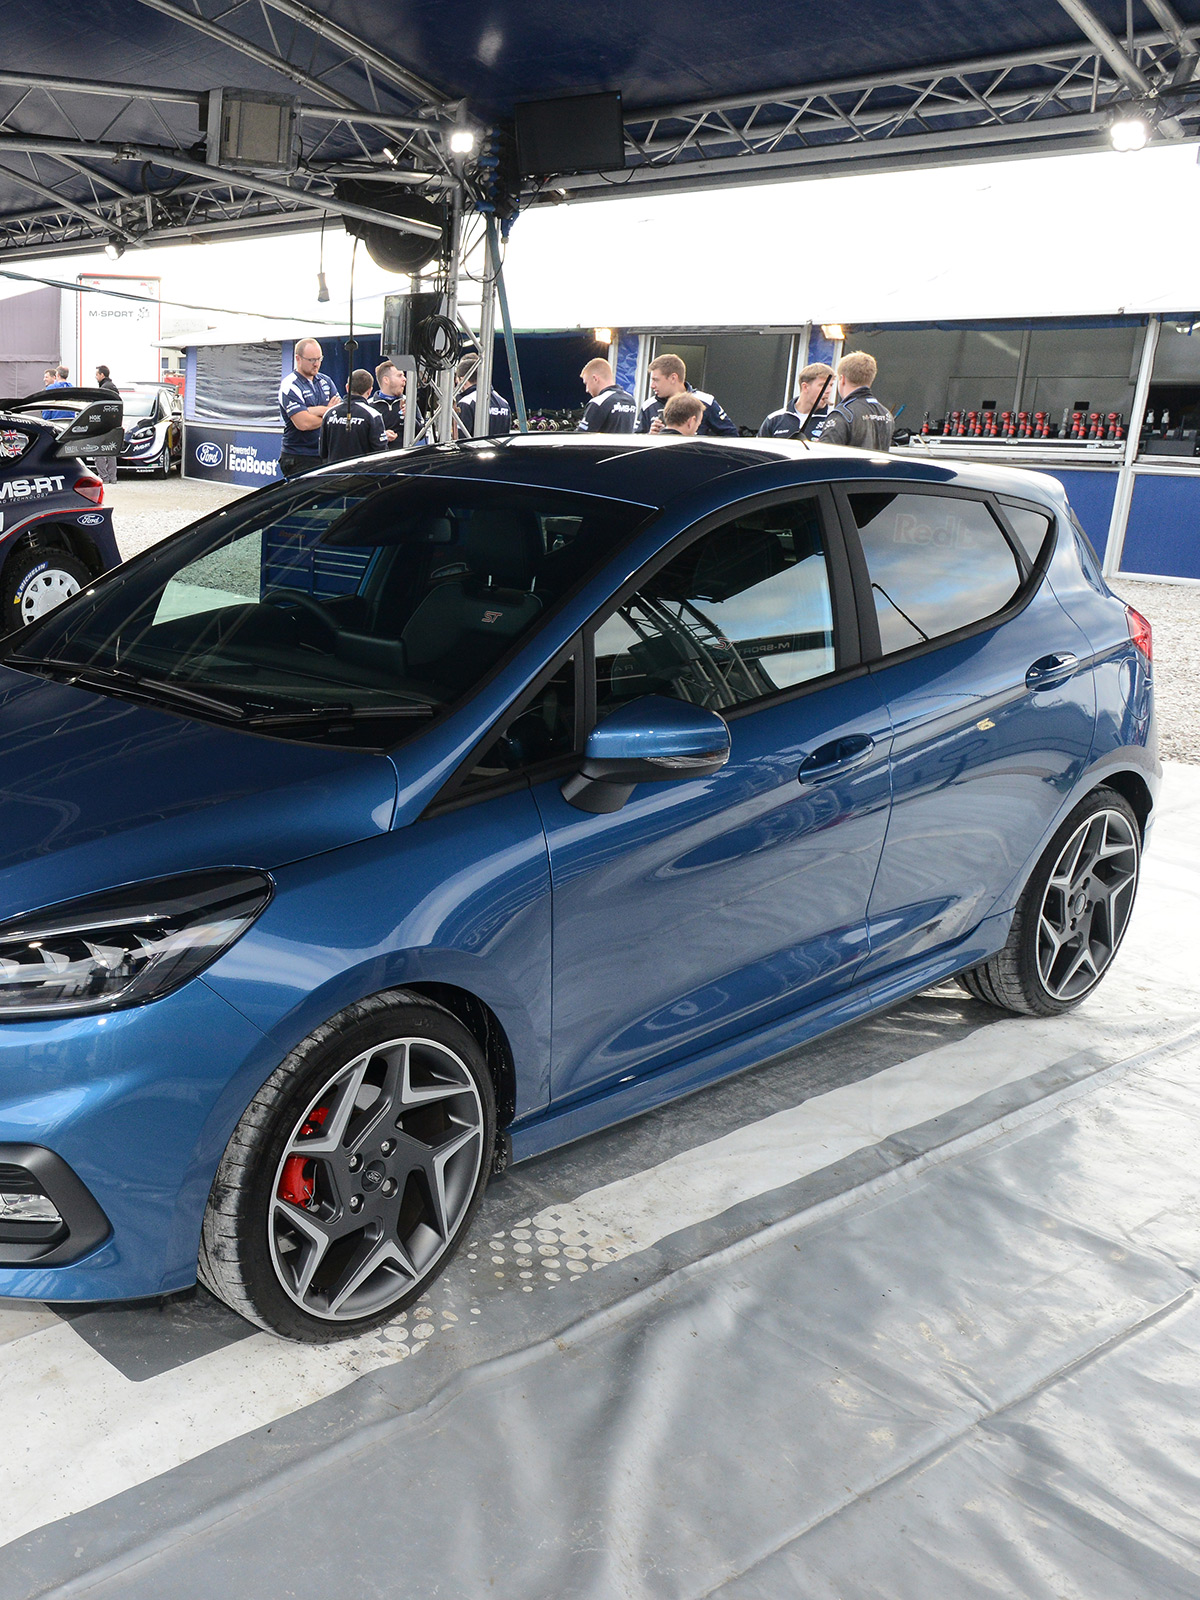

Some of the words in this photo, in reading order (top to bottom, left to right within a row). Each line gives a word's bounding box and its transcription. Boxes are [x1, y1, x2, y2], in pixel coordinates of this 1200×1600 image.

[88, 310, 134, 318] M-SPORT
[229, 444, 249, 455] Powered
[249, 446, 258, 457] by
[229, 454, 278, 477] EcoBoost
[8, 492, 49, 503] TECHNOLOGY
[19, 562, 46, 592] MICHELIN
[481, 609, 502, 623] ST
